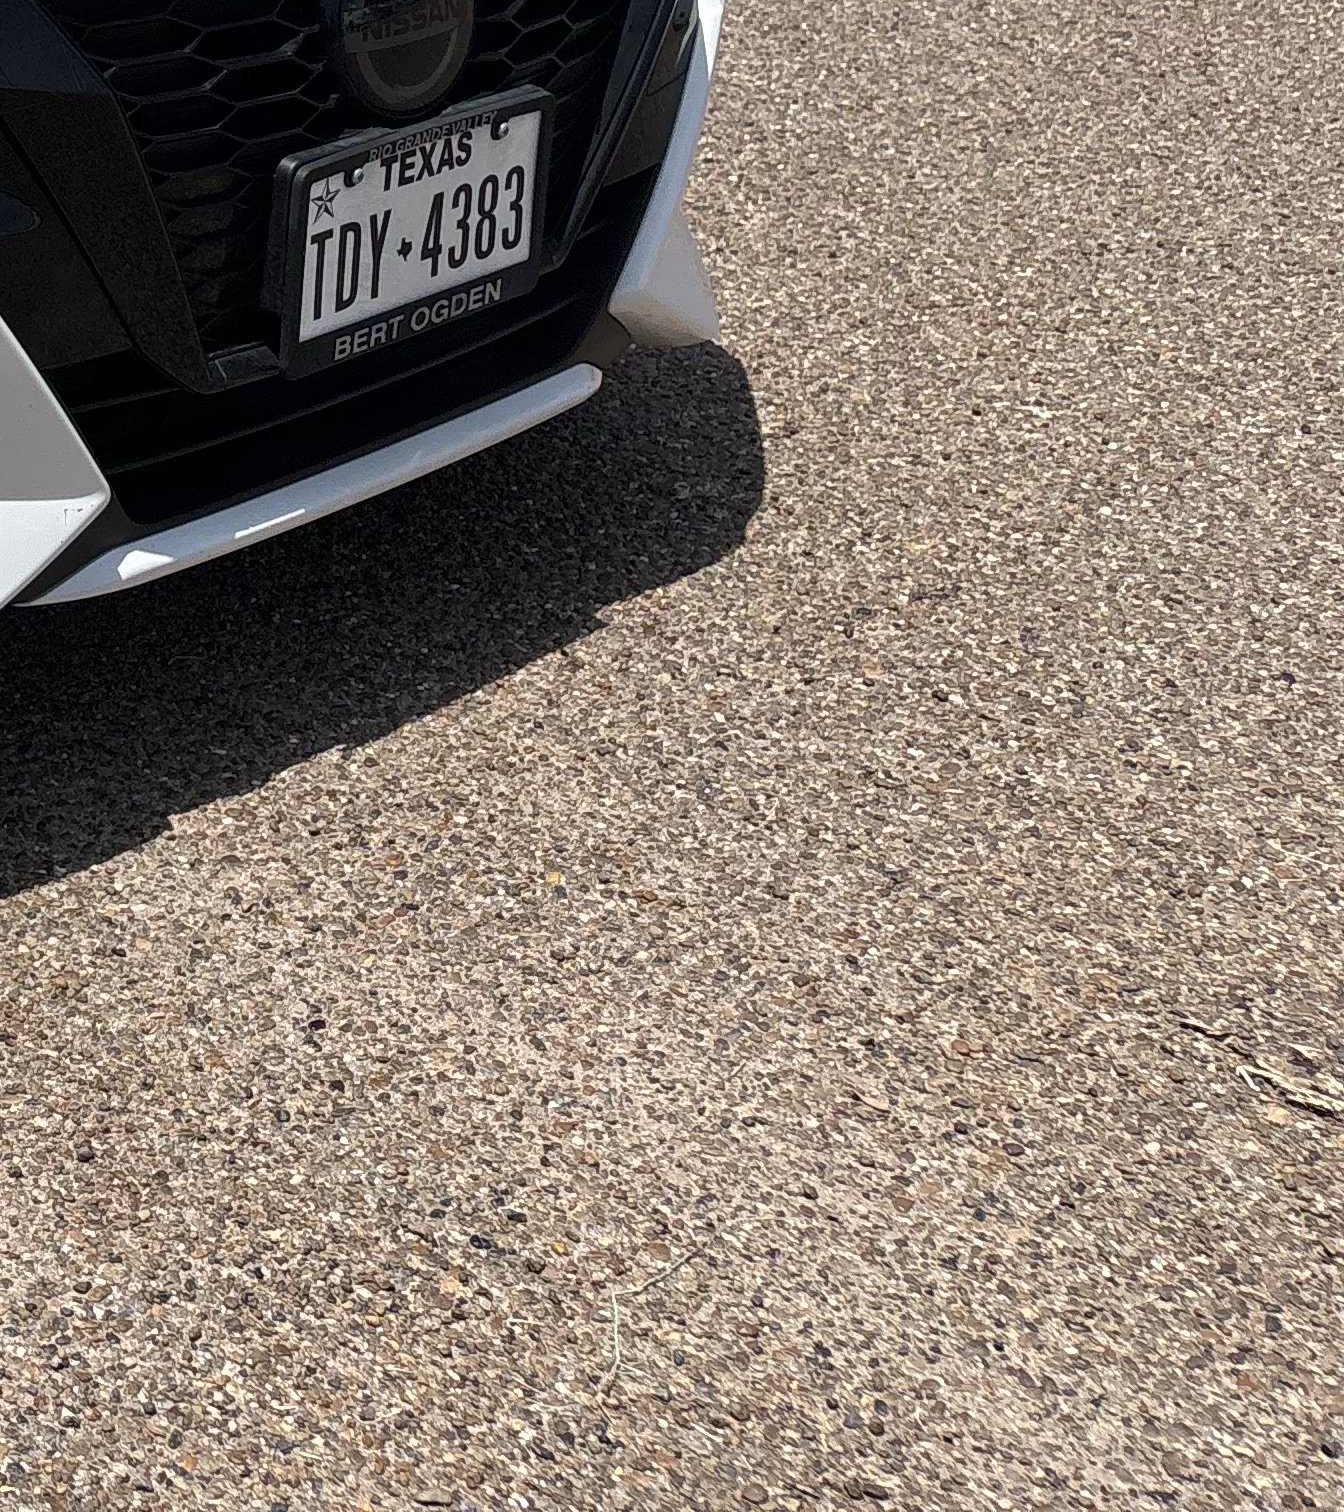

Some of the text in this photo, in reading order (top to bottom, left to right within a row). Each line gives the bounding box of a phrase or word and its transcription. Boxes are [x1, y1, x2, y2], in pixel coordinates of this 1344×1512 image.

[368, 143, 393, 162] RIO
[379, 131, 473, 192] TEXAS
[334, 278, 503, 361] BERT OGDEN
